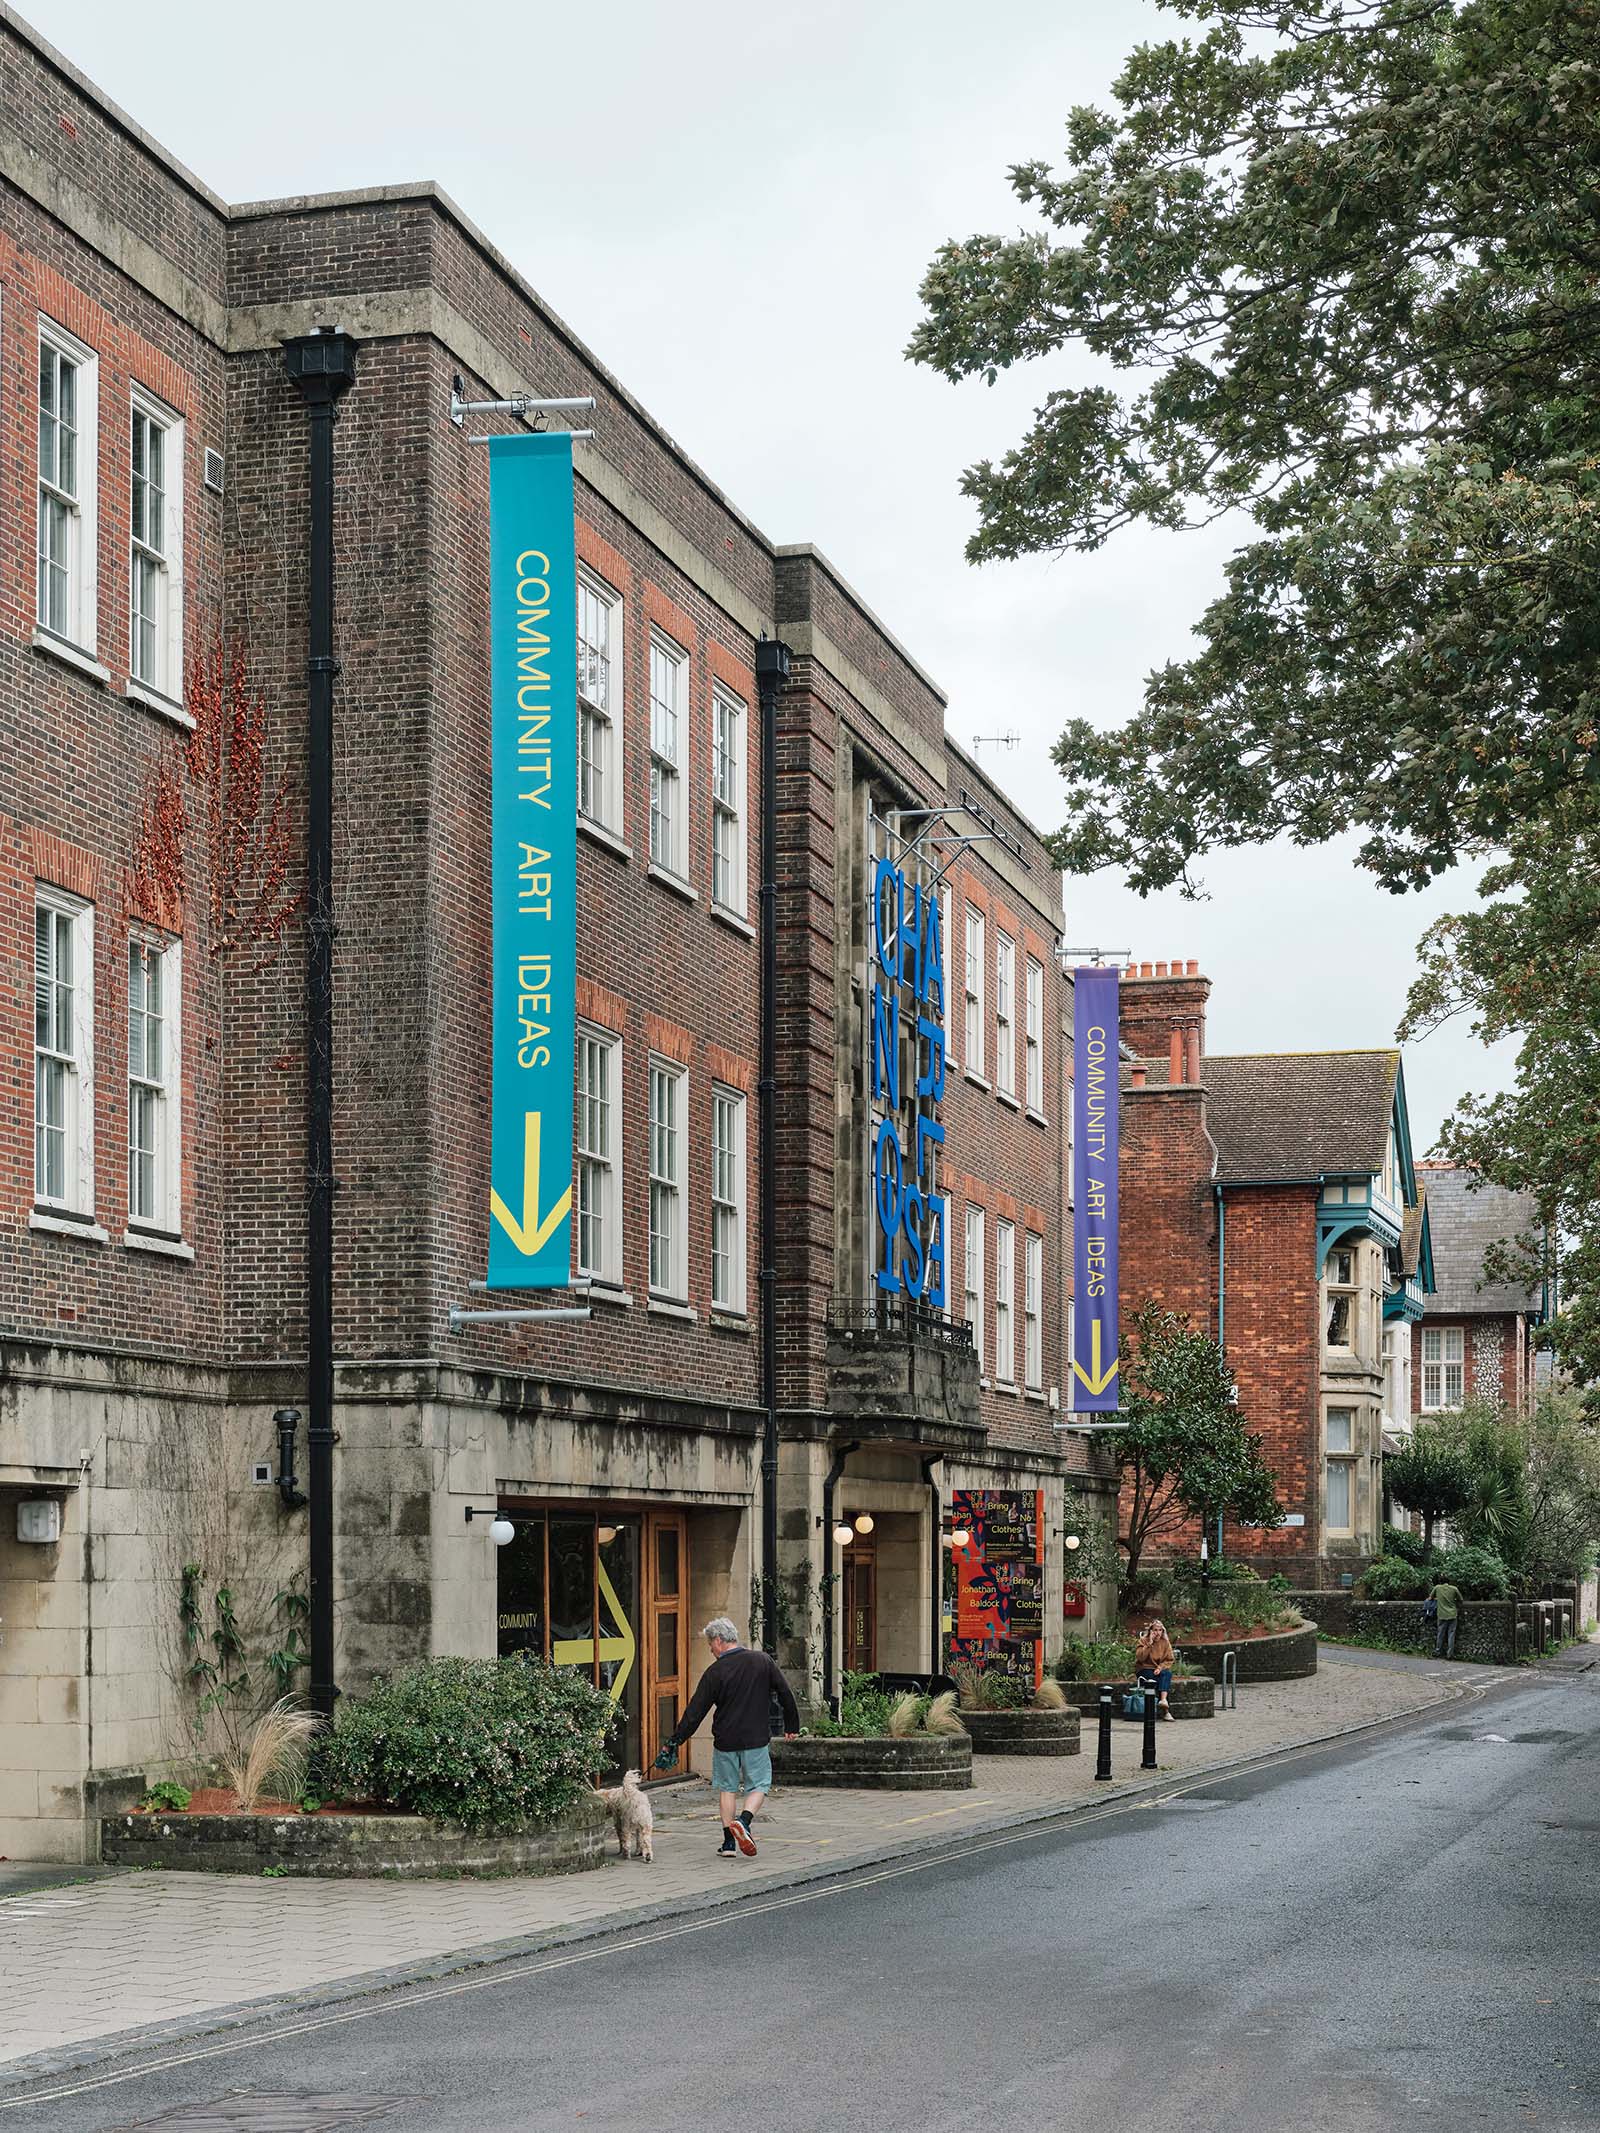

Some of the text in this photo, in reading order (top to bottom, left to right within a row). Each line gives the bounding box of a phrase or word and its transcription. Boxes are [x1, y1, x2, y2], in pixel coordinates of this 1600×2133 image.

[516, 550, 551, 1068] COMMUNITY ART IDEAS
[1086, 1025, 1105, 1297] COMMUNITY ART IDEAS
[987, 1502, 1009, 1512] Bring
[1019, 1513, 1032, 1522] No
[1012, 1576, 1034, 1587] Bring
[960, 1585, 997, 1594] Jonathan
[969, 1599, 1000, 1608] Baldock
[498, 1612, 538, 1629] COMMUNITY
[987, 1651, 1008, 1661] Bring
[1018, 1664, 1031, 1673] No
